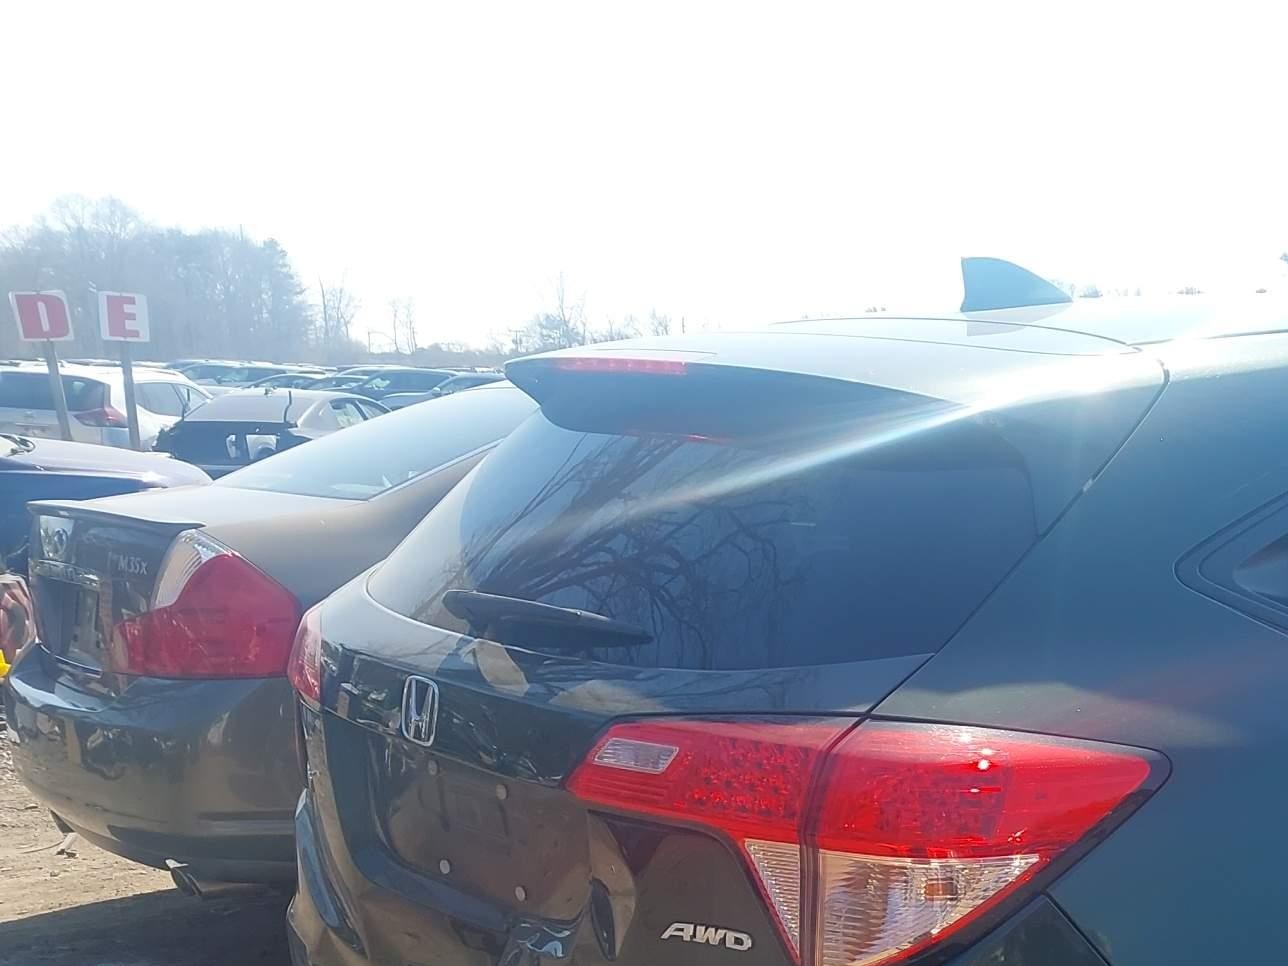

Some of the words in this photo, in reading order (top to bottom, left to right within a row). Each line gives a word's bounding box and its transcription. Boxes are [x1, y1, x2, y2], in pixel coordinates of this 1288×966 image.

[14, 293, 70, 339] D
[106, 295, 140, 338] E
[660, 922, 752, 951] AWD
